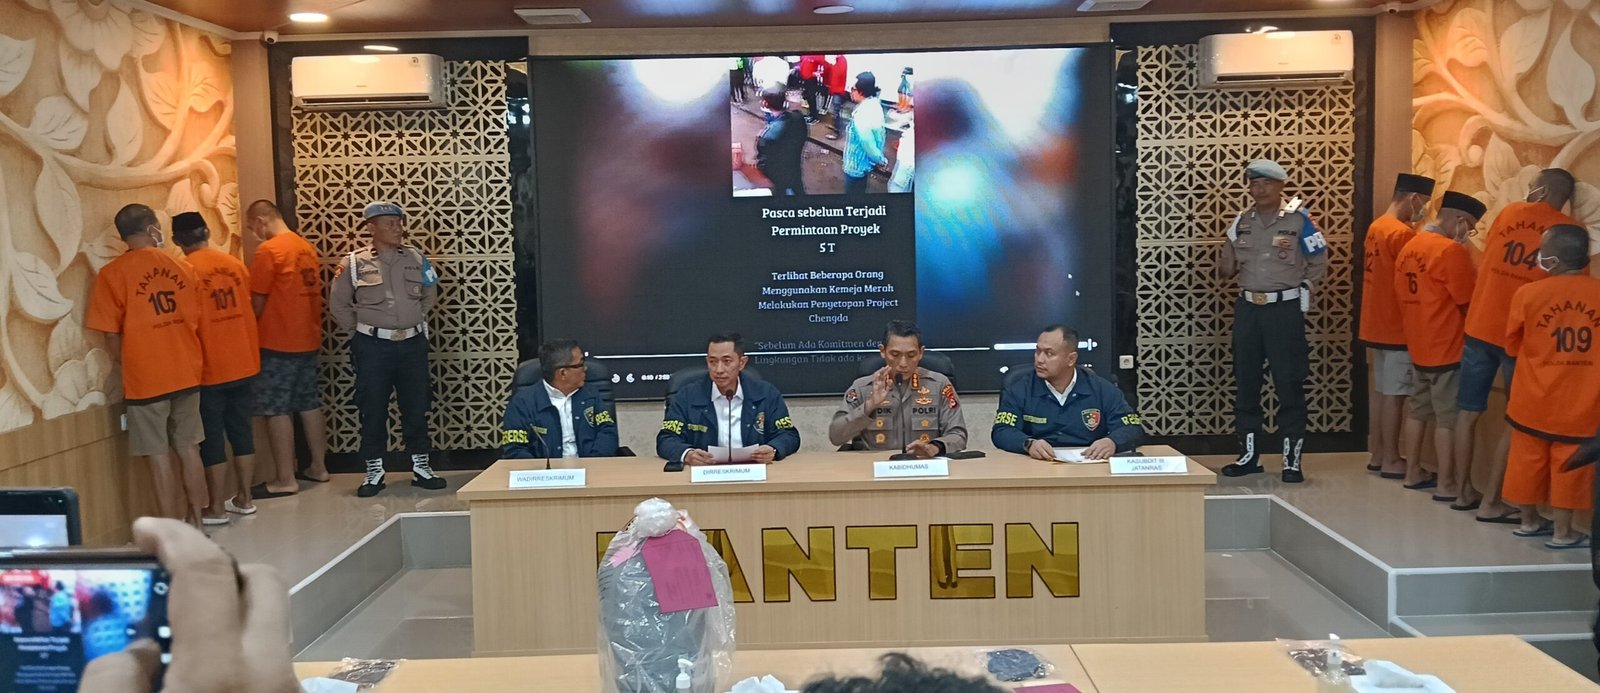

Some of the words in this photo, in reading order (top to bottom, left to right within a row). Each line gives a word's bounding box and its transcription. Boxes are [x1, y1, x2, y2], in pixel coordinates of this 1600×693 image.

[762, 208, 795, 218] Pasca
[797, 206, 844, 217] sebelum
[846, 205, 887, 219] Terjadi
[771, 225, 838, 236] Permintaan
[840, 223, 880, 237] Proyek
[827, 242, 836, 253] T
[1503, 240, 1540, 270] 104
[772, 272, 808, 280] Terlihat
[810, 270, 853, 280] Beberapa
[855, 270, 884, 280] Orang
[136, 267, 187, 297] TAHANAN
[762, 285, 827, 297] Menggunakan
[829, 285, 862, 295] Kemeja
[864, 284, 894, 293] Merah
[148, 290, 177, 315] 105
[758, 300, 809, 310] Melakukan
[866, 299, 899, 309] Project
[808, 313, 849, 324] Chengda
[798, 340, 816, 349] Ada
[818, 340, 864, 349] Komitmen
[1551, 326, 1592, 353] 109
[810, 354, 837, 363] Tidak
[703, 467, 751, 475] DIRRESKRIMUM
[889, 463, 929, 471] KABIDHUMAS
[517, 474, 575, 482] WADIRRESKRIMUM
